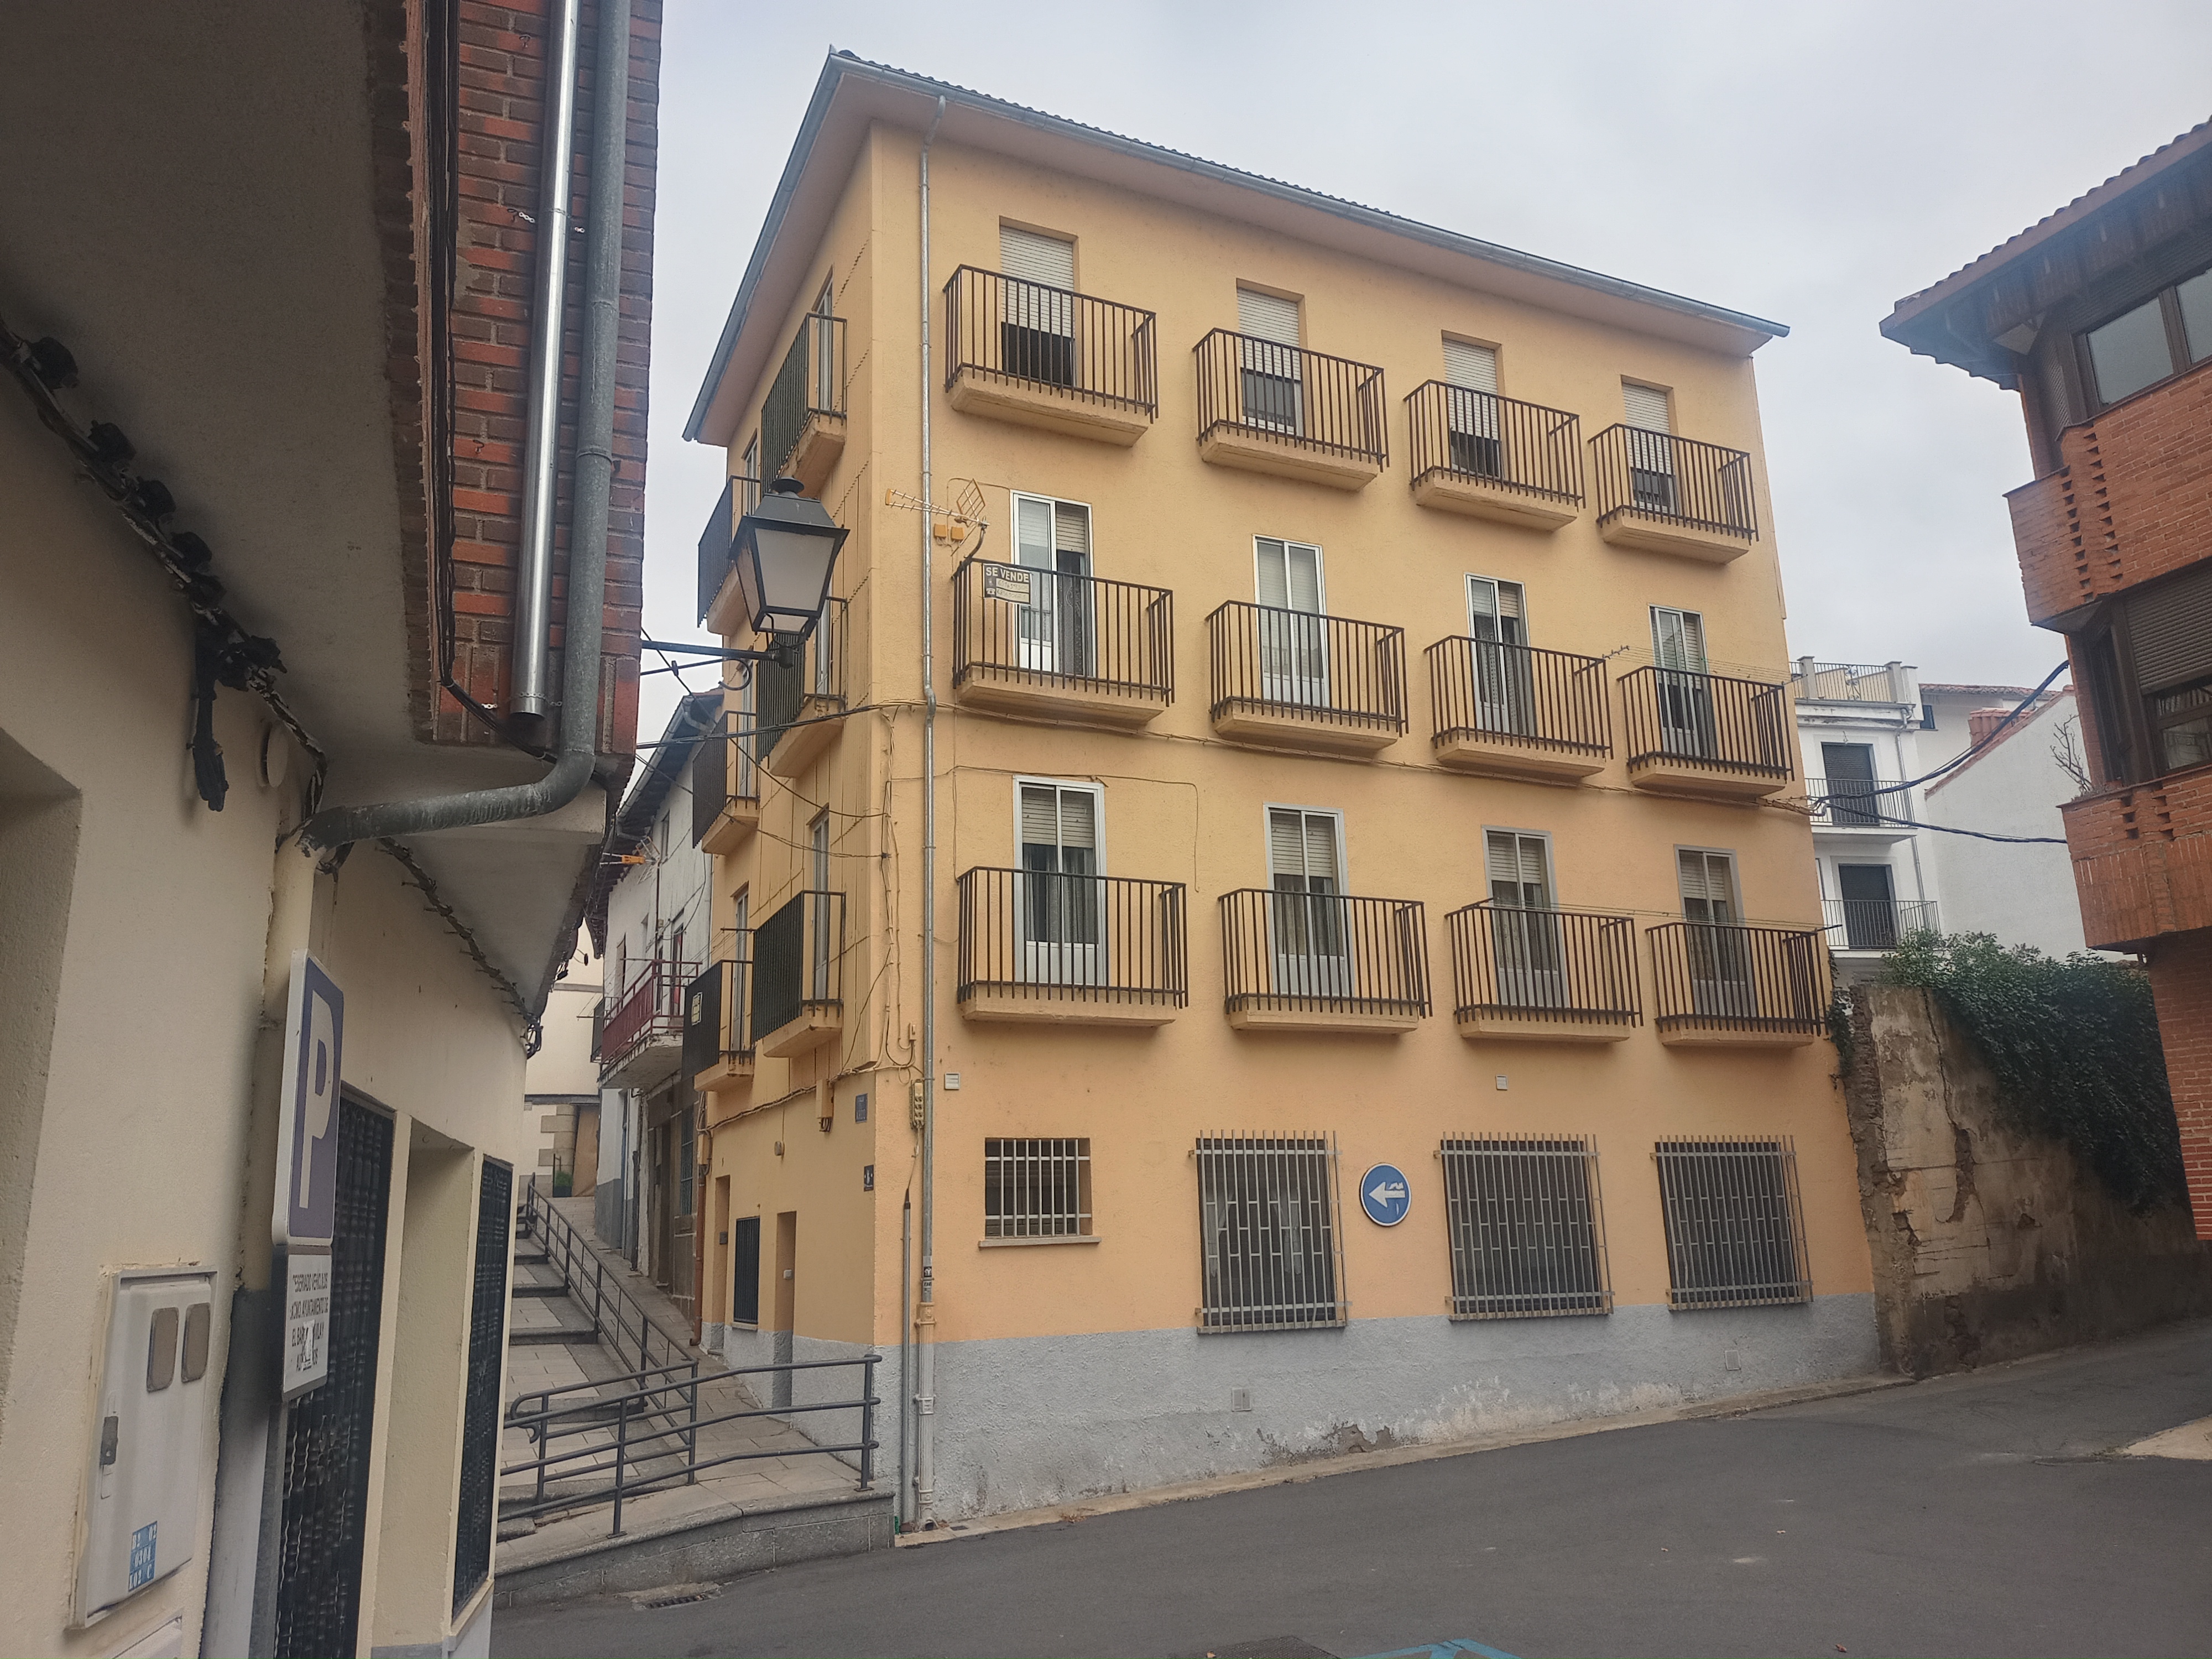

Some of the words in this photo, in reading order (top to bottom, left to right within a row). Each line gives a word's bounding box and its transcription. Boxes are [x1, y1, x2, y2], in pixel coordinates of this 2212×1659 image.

[985, 567, 998, 576] SE
[1000, 568, 1029, 583] VENDE
[299, 990, 334, 1209] P
[149, 1524, 156, 1541] 02
[147, 1564, 152, 1579] C
